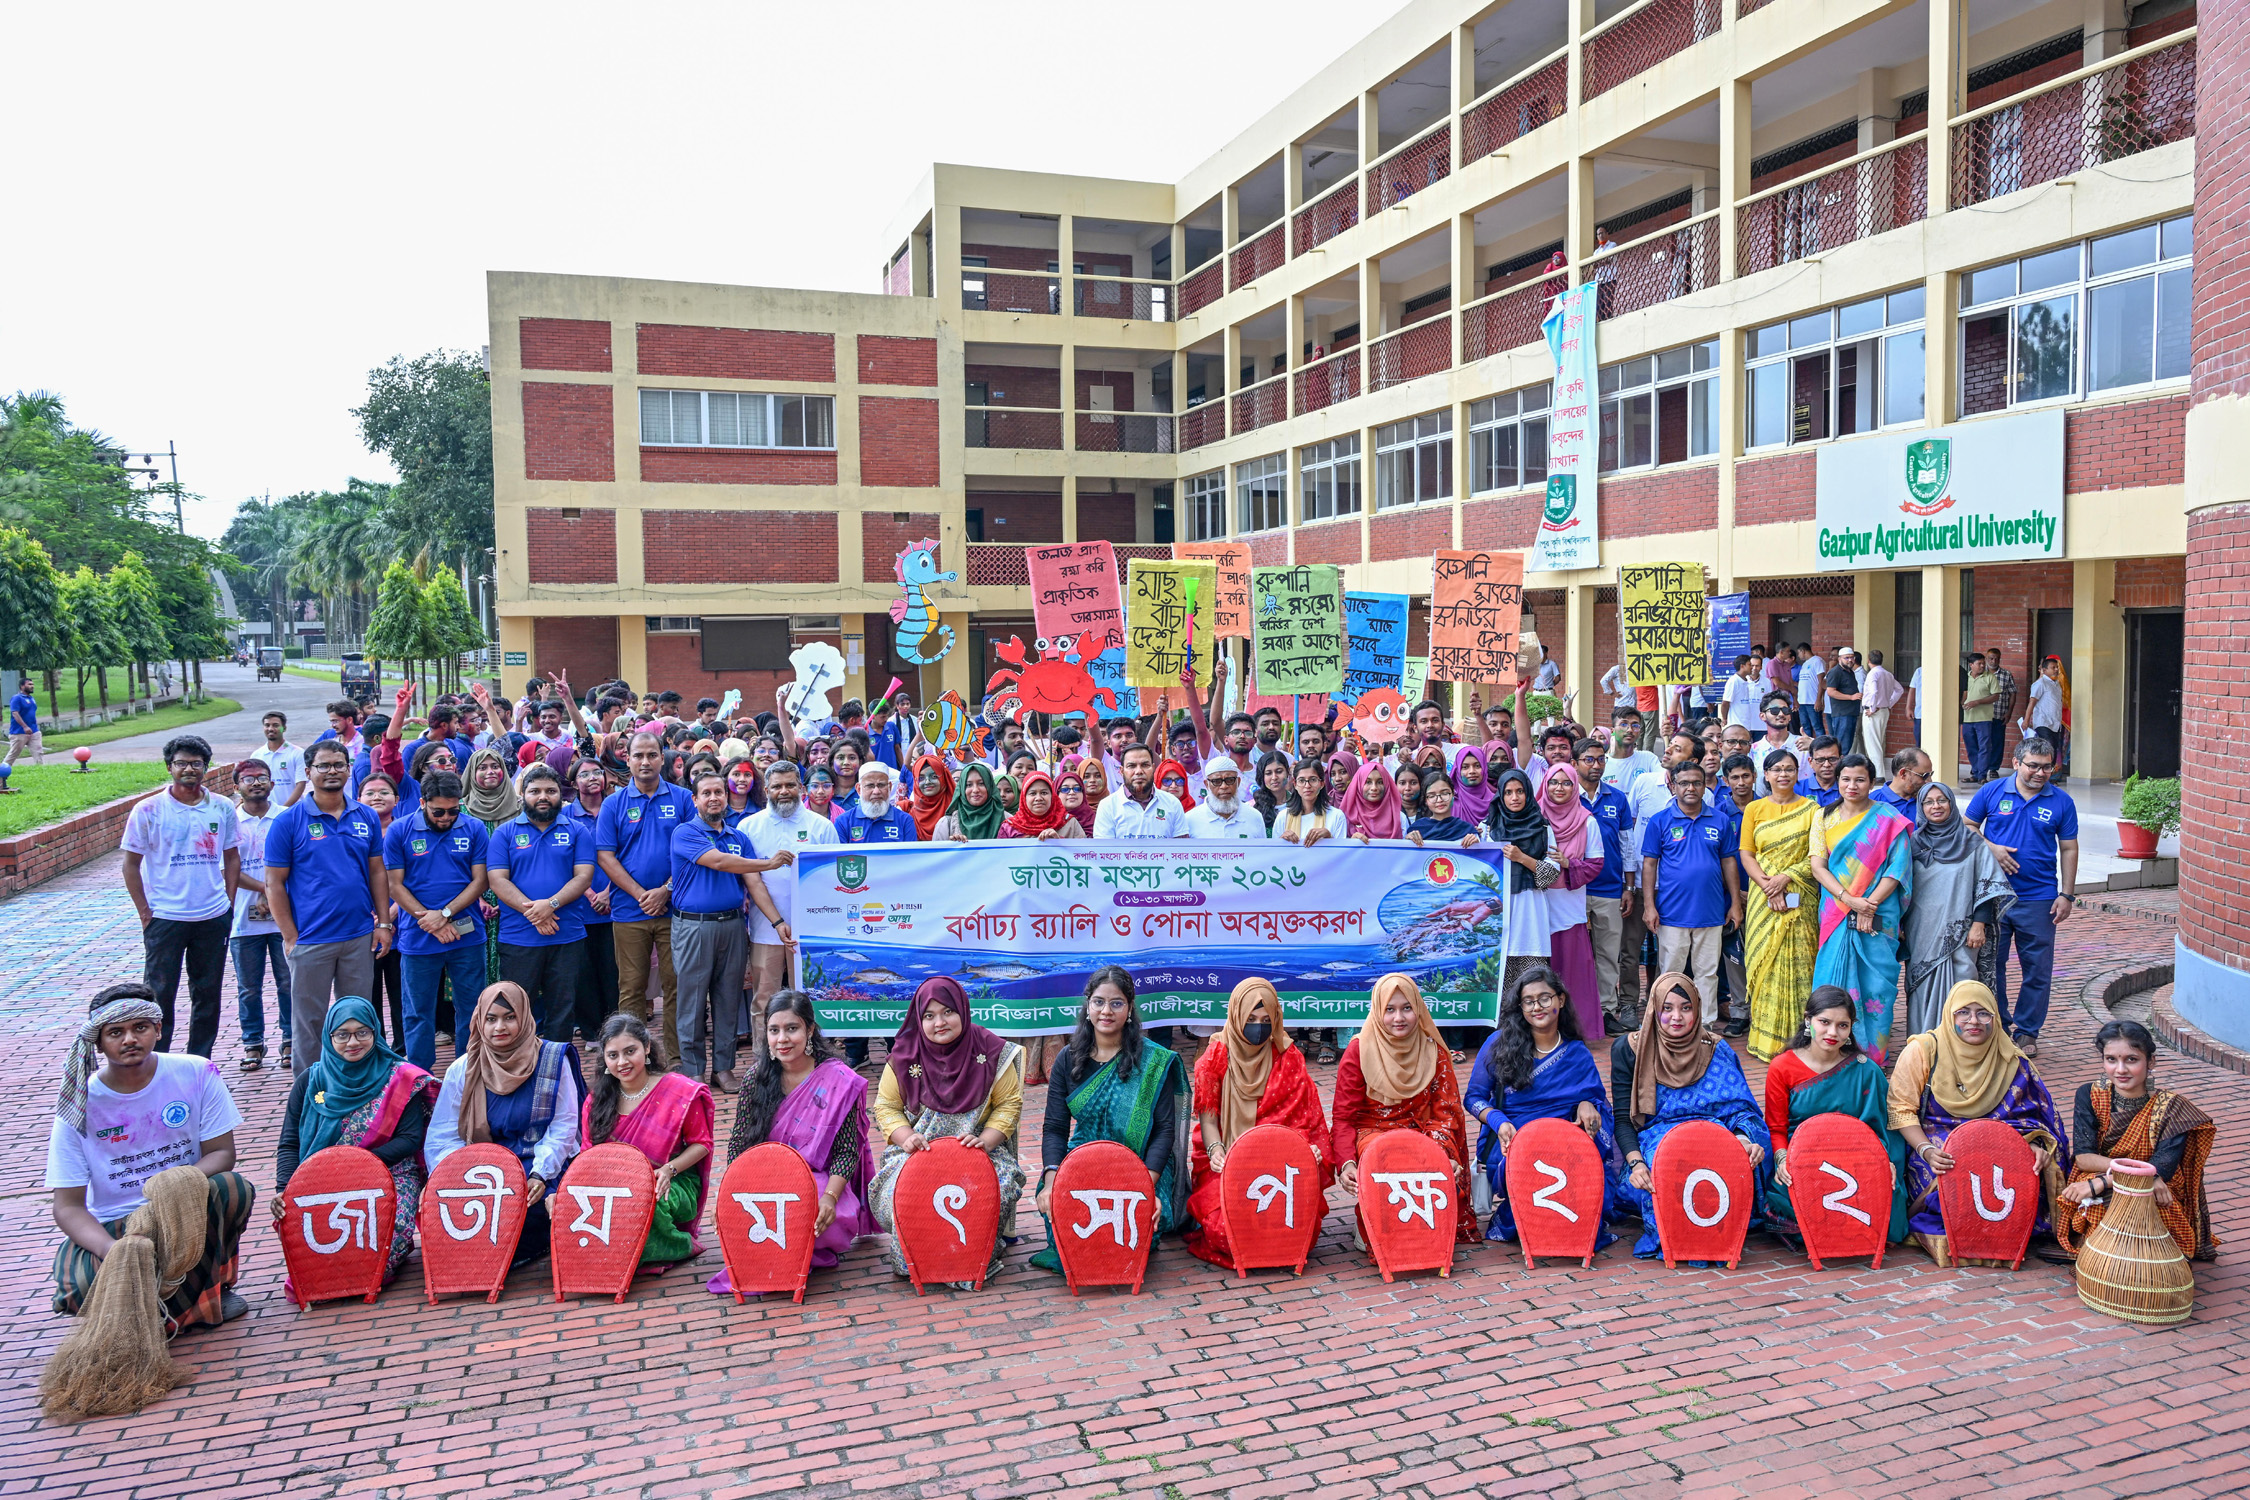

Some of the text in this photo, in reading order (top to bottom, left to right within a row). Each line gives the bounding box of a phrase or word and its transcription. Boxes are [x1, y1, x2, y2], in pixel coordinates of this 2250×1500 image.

[1566, 378, 1585, 400] কৃষি
[1911, 483, 1940, 499] Agricultural
[1937, 452, 1948, 486] University
[1819, 509, 2057, 563] Gazipur Agricultural University
[1037, 545, 1102, 560] জলজ প্রাণ
[1085, 557, 1106, 573] করি
[1136, 570, 1179, 602] মাছ
[1256, 565, 1312, 593] রুপালি
[1622, 562, 1685, 591] রুপালি
[1040, 581, 1099, 606] প্রাকৃতিক
[1224, 588, 1247, 606] করি
[1070, 608, 1119, 623] ভারসাম্য
[1299, 616, 1326, 630] দেশ
[1675, 607, 1705, 628] দেশ
[1105, 628, 1124, 647] াখি
[1133, 626, 1178, 649] দেশ
[1261, 633, 1341, 652] সবার আগে
[1477, 630, 1513, 650] দেশ
[1624, 626, 1669, 651] সবার
[1668, 627, 1706, 655] আগে
[1264, 655, 1341, 681] বাংলাদেশ
[1432, 664, 1502, 684] বাংলাদেশ
[1476, 649, 1519, 673] আগে
[1627, 652, 1708, 683] বাংলাদেশ
[1073, 850, 1097, 861] রুপালি
[1100, 852, 1121, 861] মৎস্যে
[1124, 850, 1148, 861] স্বনির্ভর
[1171, 852, 1189, 861] সবার
[1191, 852, 1209, 861] আগে
[1211, 852, 1245, 861] বাংলাদেশ
[1008, 856, 1306, 891] জাতীয় মৎস্য পক্ষ ২০২৬
[1119, 893, 1199, 906] (১৬-৩০ আগস্ট)
[943, 904, 1021, 942] বর্ণাঢ্য
[1110, 914, 1131, 937] ও
[1143, 910, 1213, 939] পোনা
[1217, 907, 1368, 943] অবমুক্তকরণ
[1144, 973, 1173, 985] আগস্ট
[1176, 975, 1204, 986] ২০২৬
[970, 1004, 1054, 1021] স্যবিজ্ঞান
[1140, 995, 1214, 1014] গাজীপুর
[1426, 996, 1471, 1016] জীপুর
[96, 1125, 125, 1138] আস্থা
[110, 1154, 135, 1166] জাতীয়
[135, 1149, 155, 1161] মৎস্য
[120, 1179, 140, 1190] সবার
[1246, 1162, 1300, 1229] প
[1532, 1159, 1580, 1223] ২
[1817, 1160, 1872, 1227] ২
[1968, 1163, 2016, 1222] ৬
[436, 1164, 515, 1246] তী
[1370, 1171, 1448, 1230] ক্ষ
[1682, 1168, 1731, 1228] ০
[292, 1187, 386, 1255] জা
[566, 1185, 633, 1249] য়
[730, 1192, 801, 1250] ম
[932, 1184, 968, 1246] ৎ
